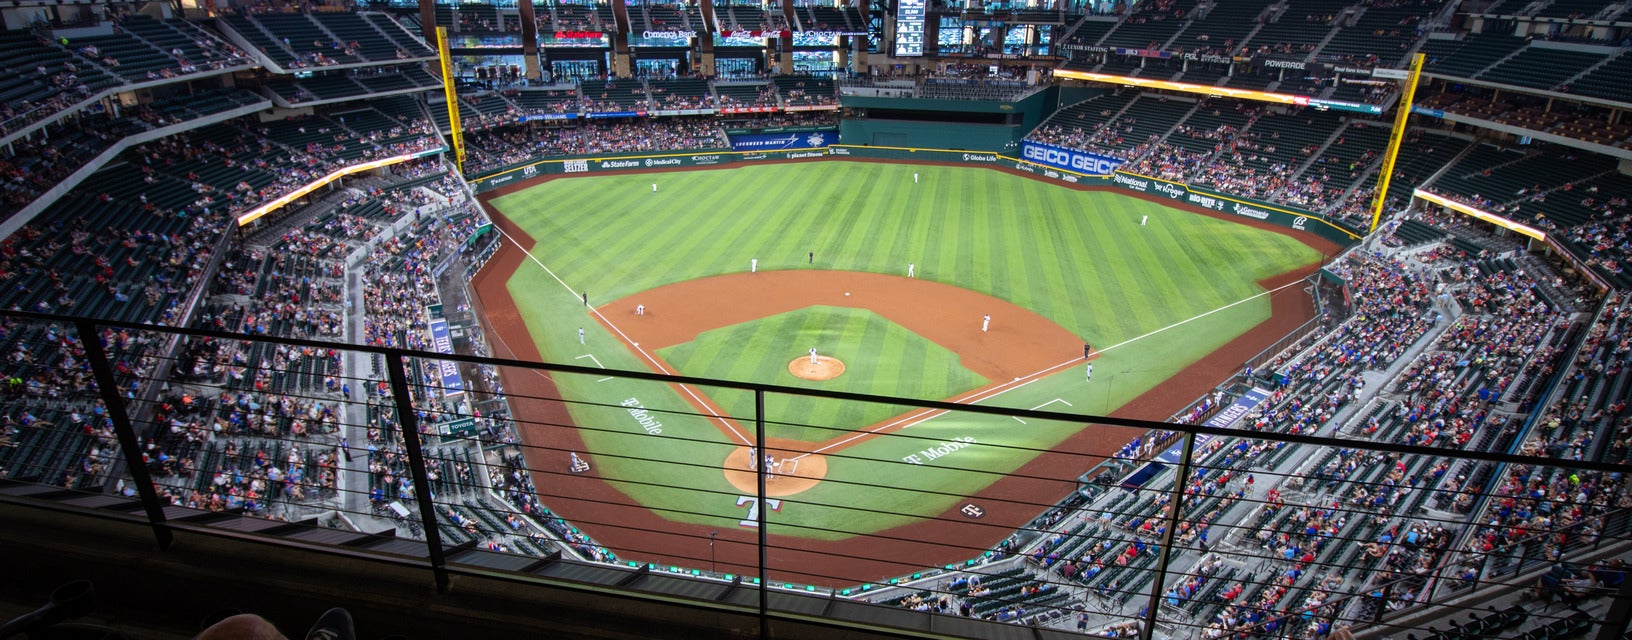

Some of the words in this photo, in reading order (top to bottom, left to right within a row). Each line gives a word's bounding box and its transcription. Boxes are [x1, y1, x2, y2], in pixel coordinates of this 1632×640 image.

[677, 30, 698, 38] Bank
[1264, 60, 1306, 70] POWERADE
[1023, 145, 1069, 165] GEICO
[564, 163, 588, 173] SELTZER
[1121, 176, 1148, 188] National
[1162, 184, 1185, 198] Kroger
[451, 421, 473, 430] TOYOTA
[626, 405, 662, 434] Mobile
[918, 436, 976, 461] Mobile
